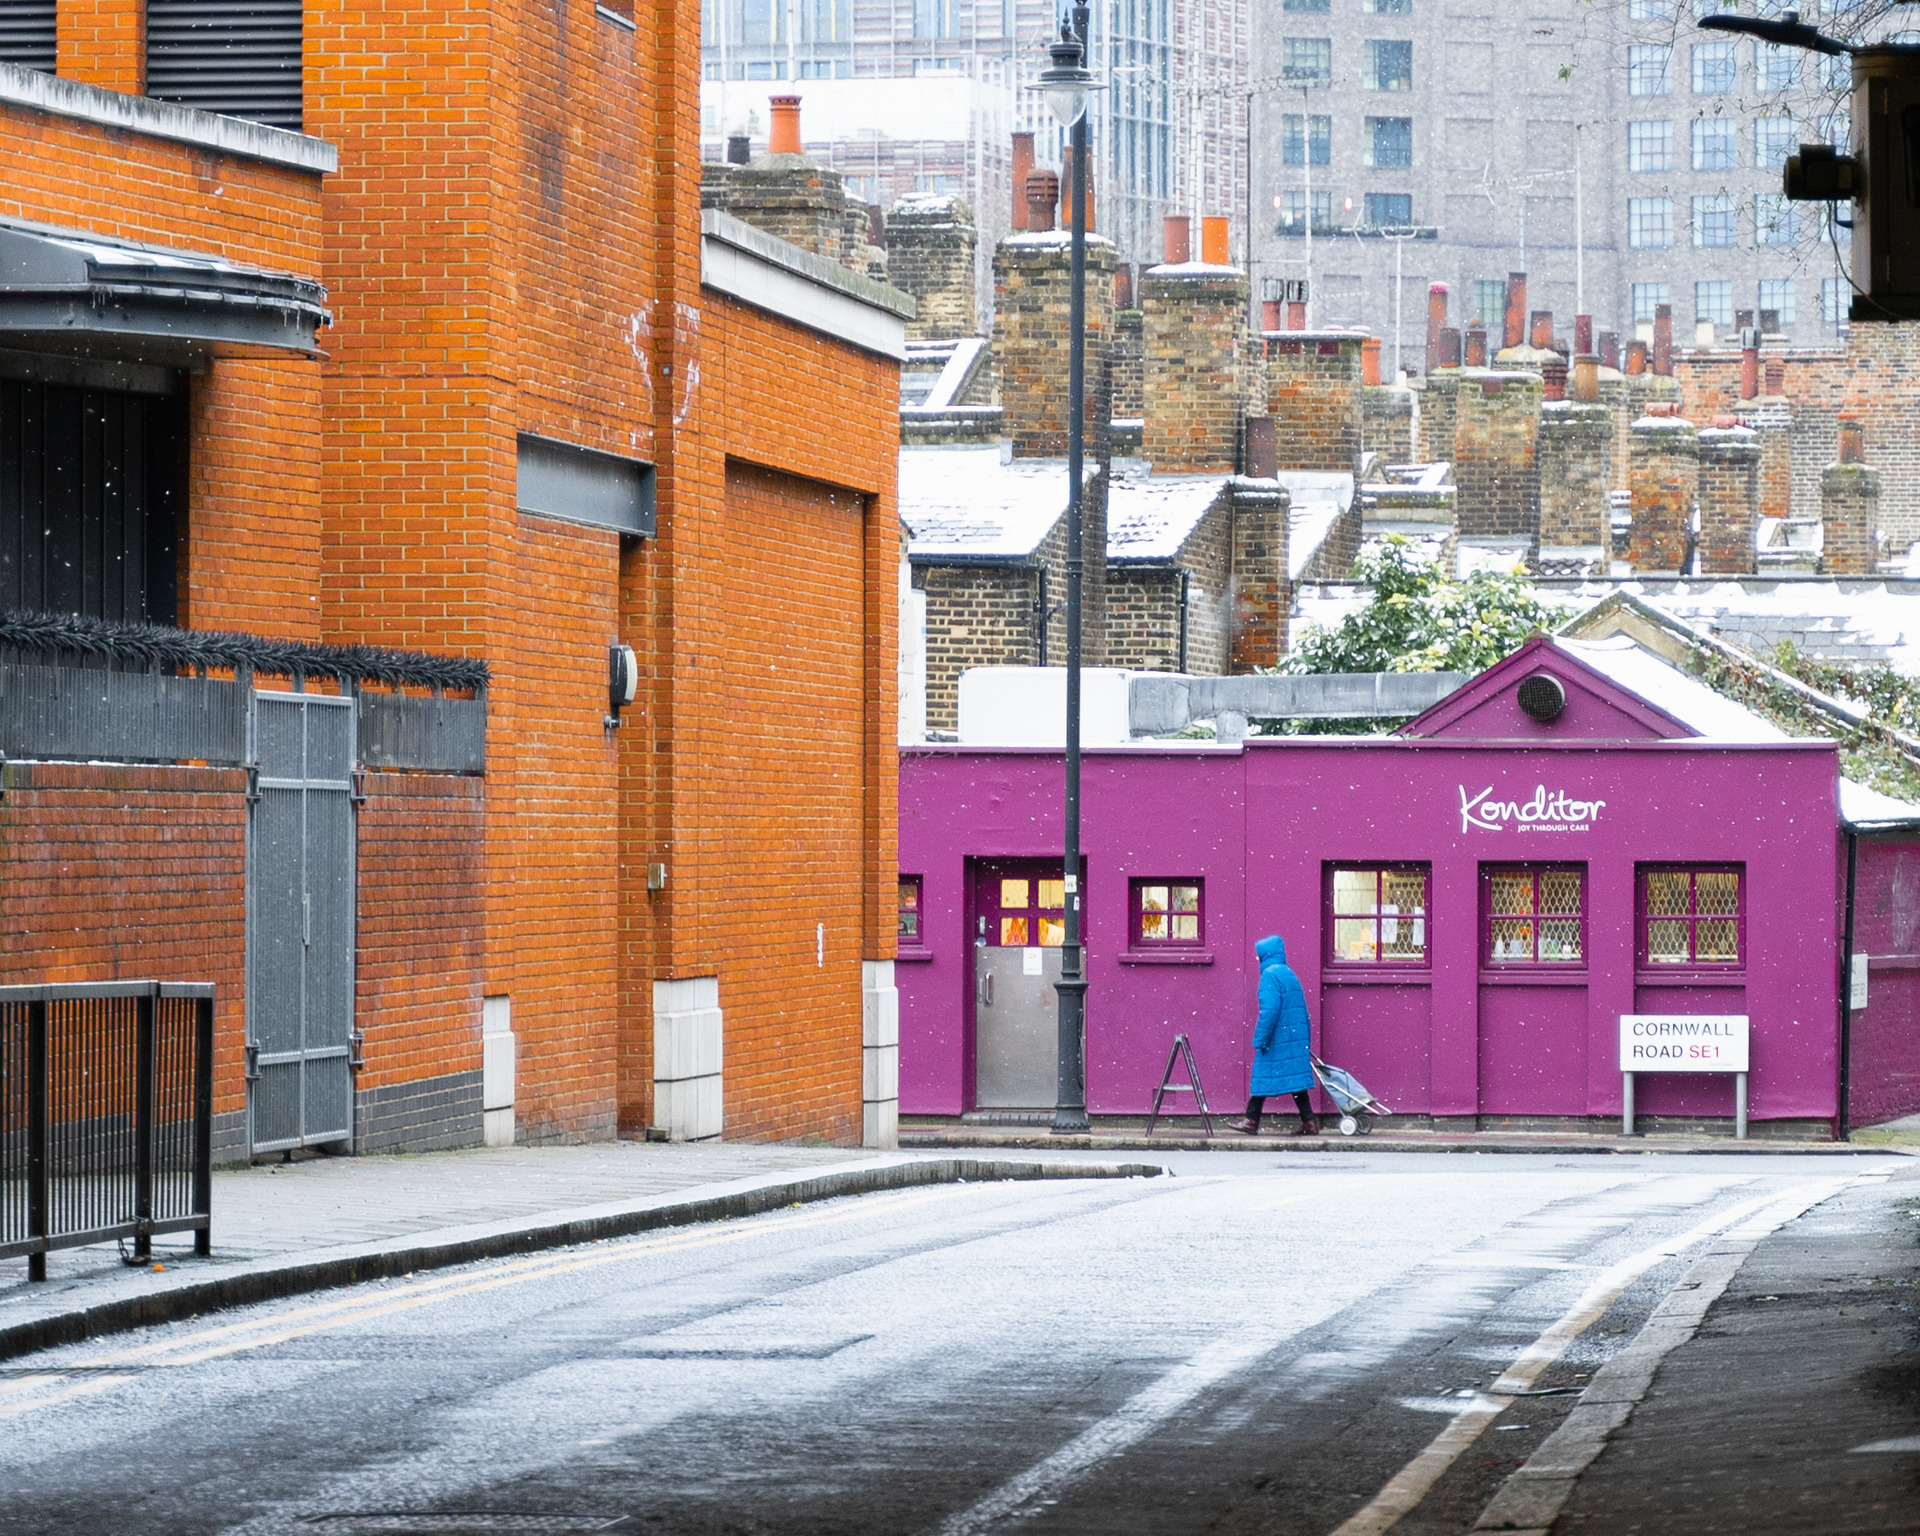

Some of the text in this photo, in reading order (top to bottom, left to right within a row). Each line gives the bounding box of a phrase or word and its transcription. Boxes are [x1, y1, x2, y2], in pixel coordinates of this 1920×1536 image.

[1459, 784, 1606, 834] Konditor
[1518, 824, 1589, 833] JOY THROUGH CAKE
[1633, 1022, 1734, 1036] CORNWALL
[1633, 1045, 1719, 1058] ROAD SE1
